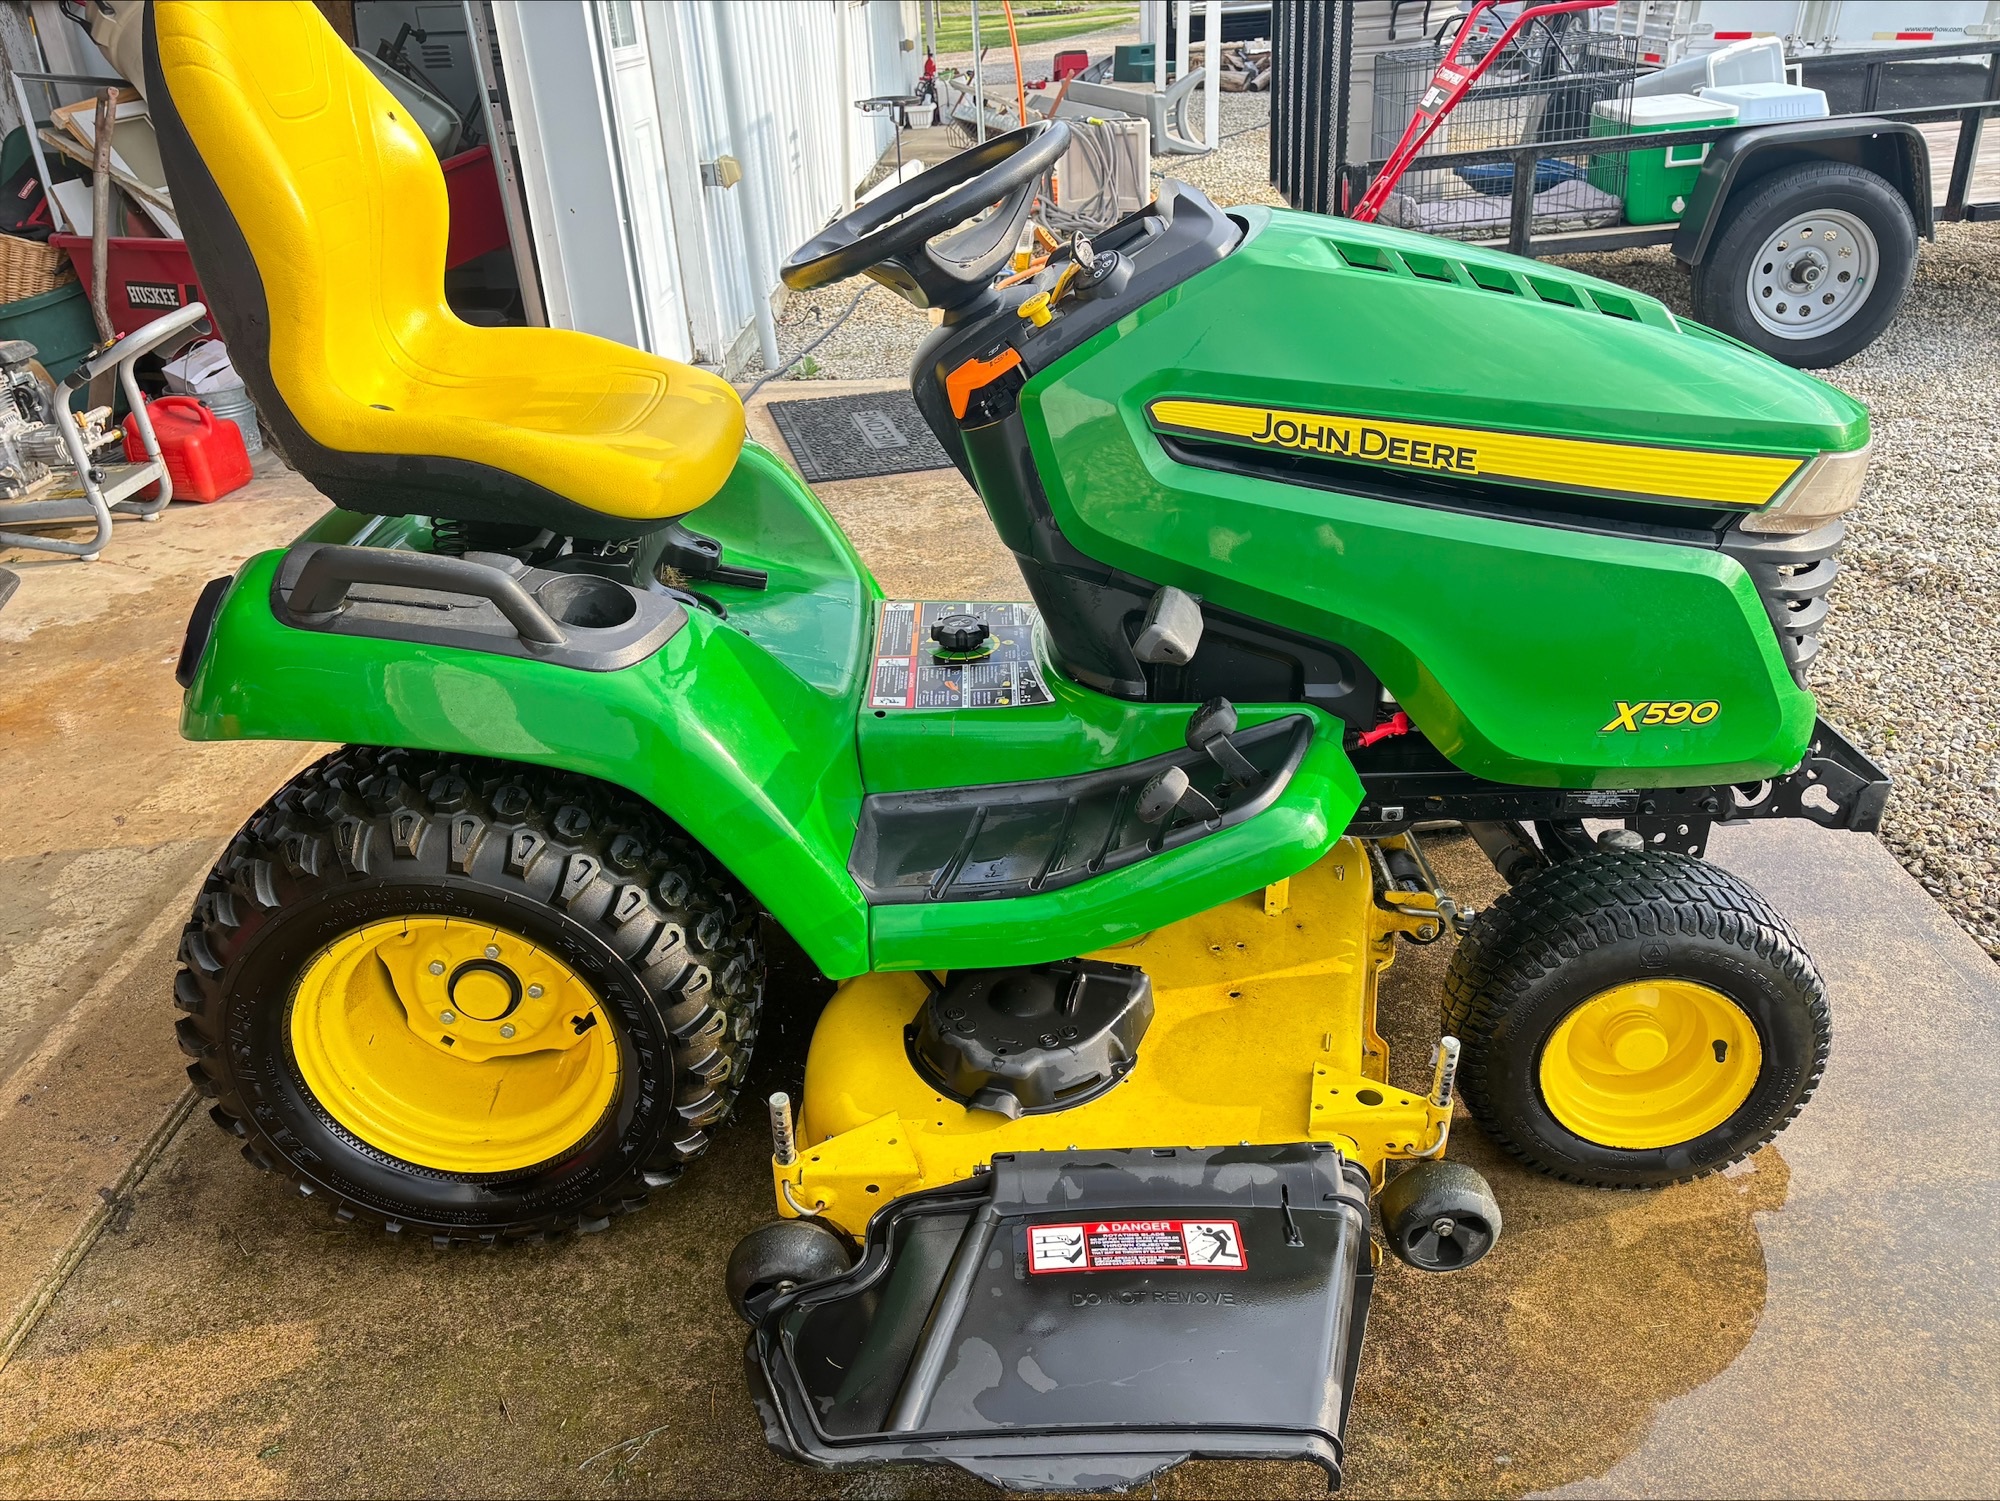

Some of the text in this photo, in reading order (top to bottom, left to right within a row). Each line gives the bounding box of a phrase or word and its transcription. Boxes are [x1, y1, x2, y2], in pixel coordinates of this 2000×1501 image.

[1904, 25, 1963, 33] www.merhow.com
[127, 285, 180, 306] HUSKEE
[858, 411, 900, 447] WELCOME
[1252, 412, 1479, 472] JOHN DEERE
[1600, 700, 1721, 732] X590
[1111, 1222, 1171, 1232] DANGER
[1071, 1290, 1238, 1308] DO NOT REMOVE
